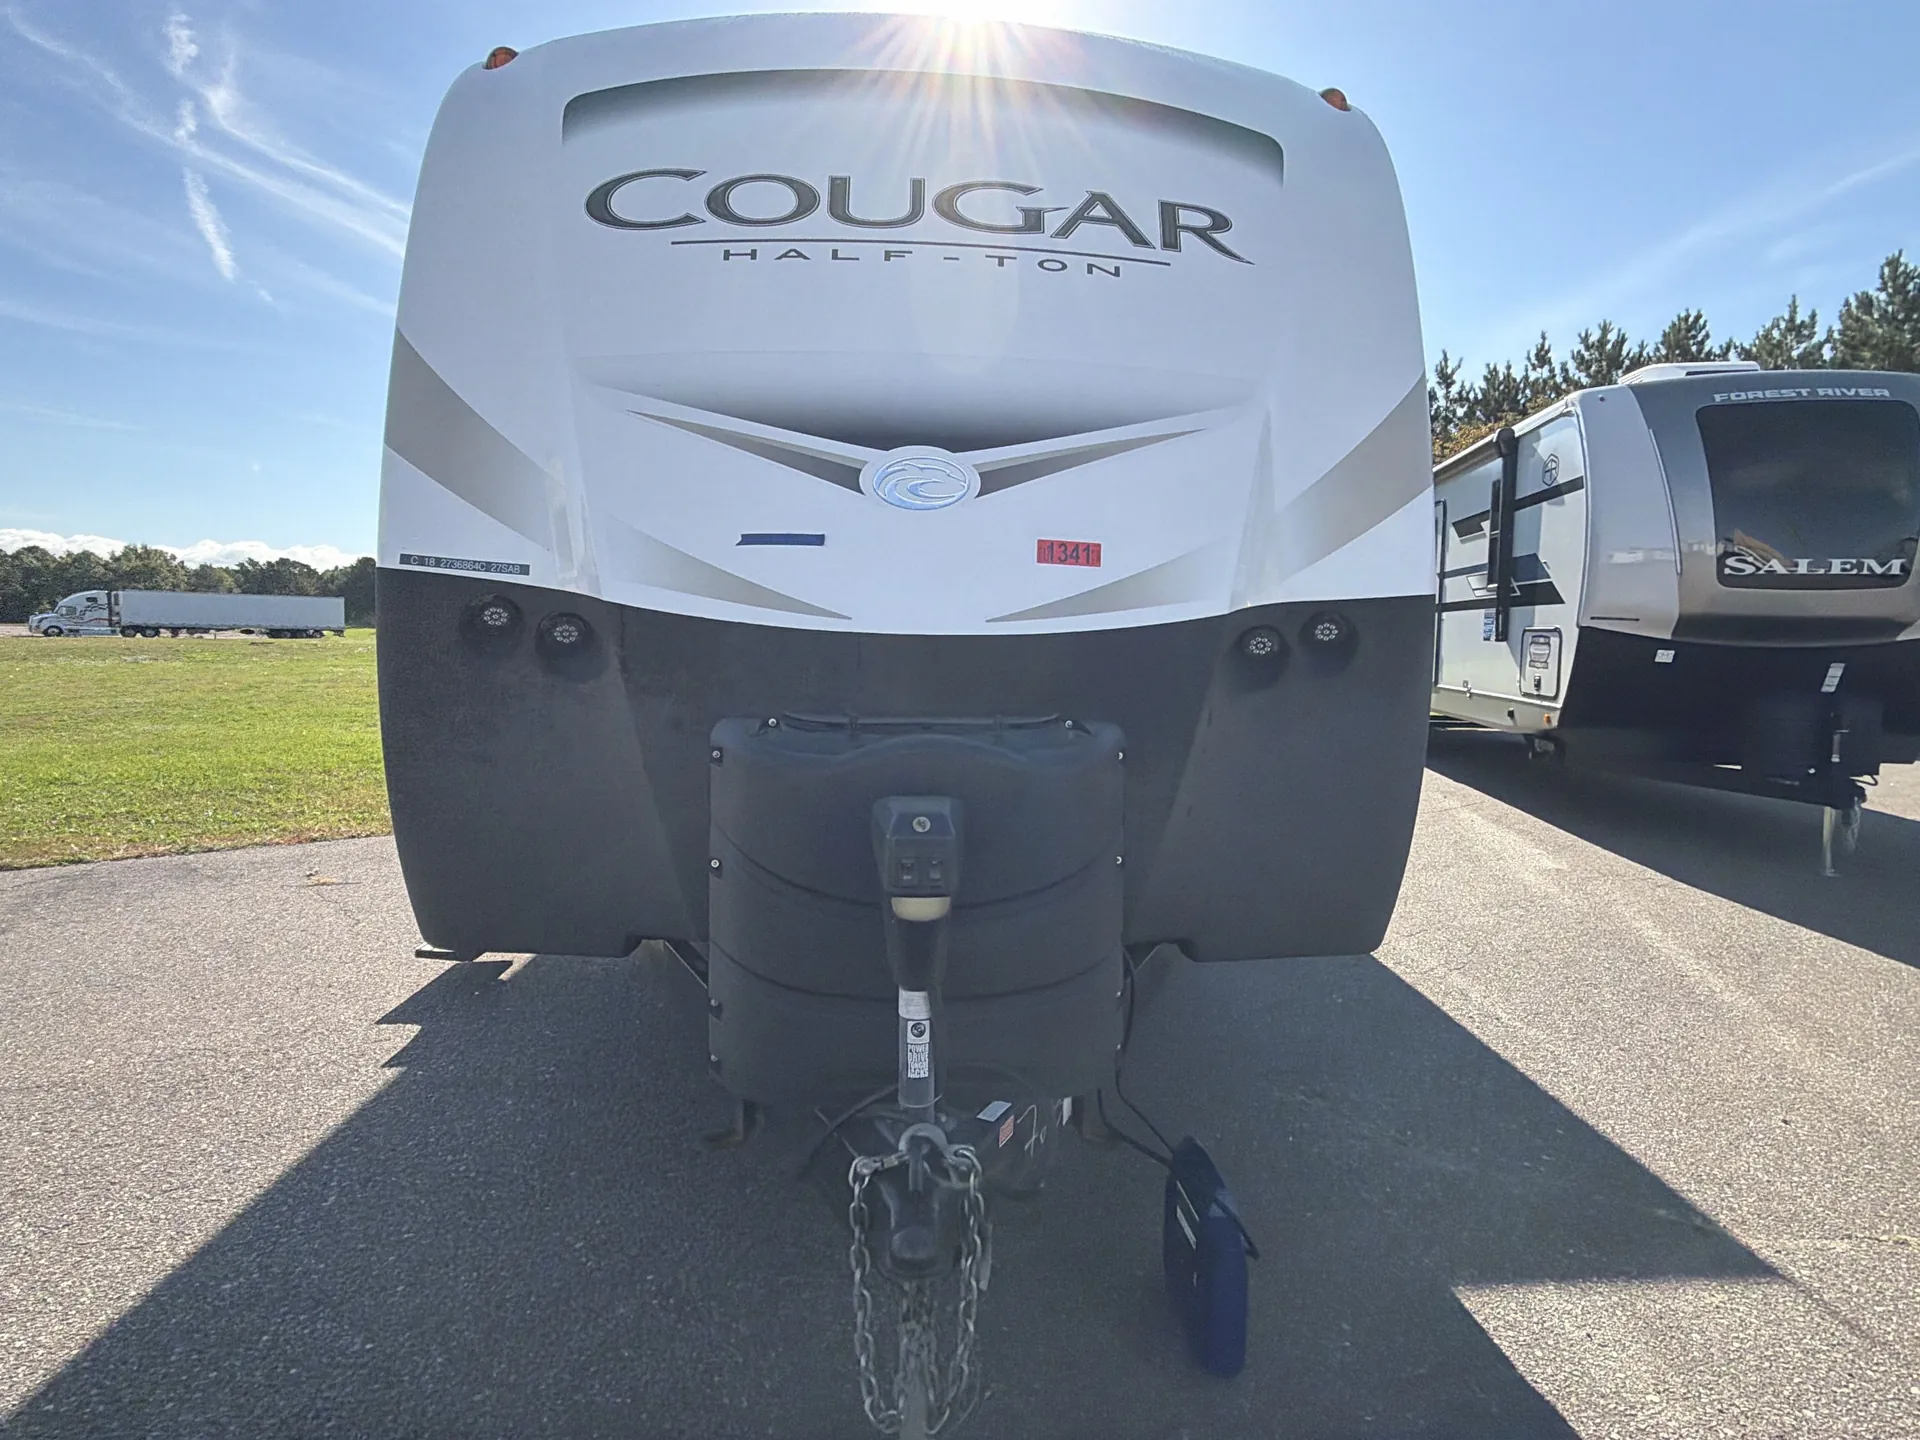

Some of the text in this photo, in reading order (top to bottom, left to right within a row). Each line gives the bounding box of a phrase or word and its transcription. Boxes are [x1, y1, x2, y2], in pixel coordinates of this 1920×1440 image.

[584, 167, 1255, 266] COUGAR
[722, 248, 1121, 278] HALF-TON
[1713, 388, 1890, 402] FOREST RIVER
[1046, 540, 1091, 565] 1341
[410, 555, 419, 565] C
[424, 557, 436, 567] 18
[490, 563, 521, 574] 27SAB
[1723, 555, 1907, 576] SALEM
[907, 1052, 929, 1062] DRIVE
